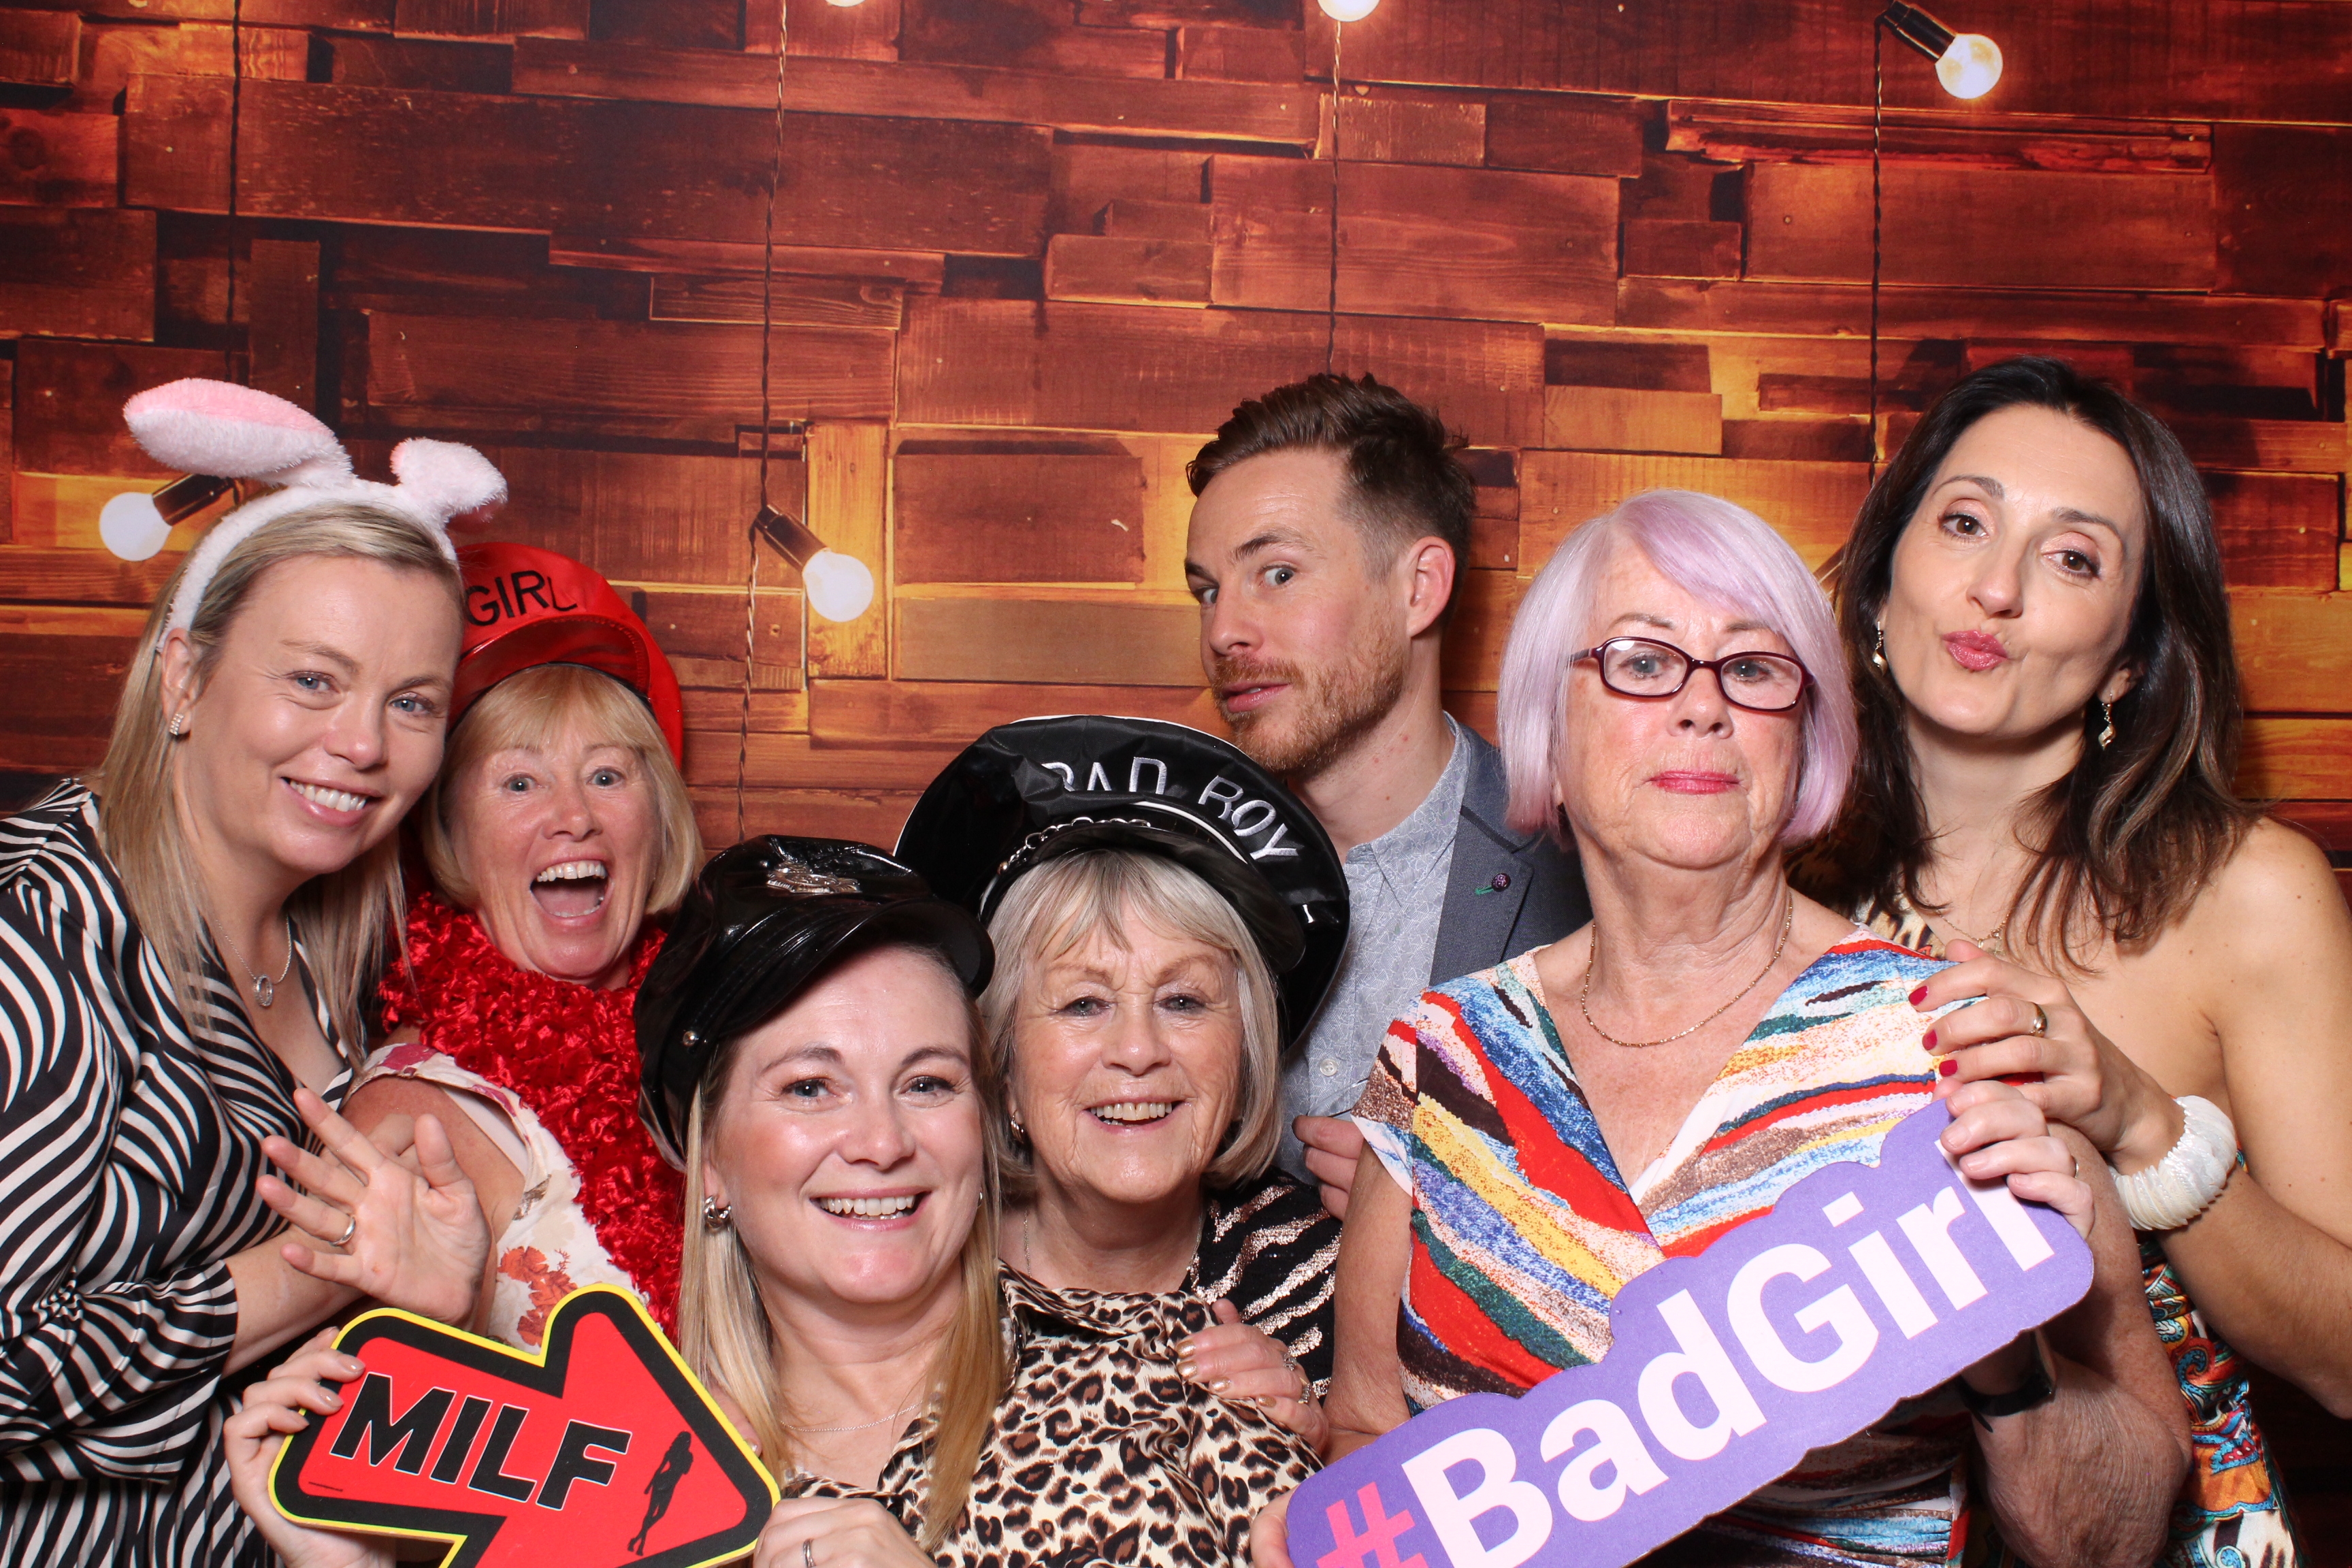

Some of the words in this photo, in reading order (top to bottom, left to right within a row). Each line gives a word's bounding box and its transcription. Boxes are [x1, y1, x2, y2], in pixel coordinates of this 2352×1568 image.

[465, 570, 578, 626] GIRL
[1198, 775, 1298, 860] BOY
[1316, 1139, 2055, 1568] #BadGirl
[329, 1372, 633, 1510] MILF
